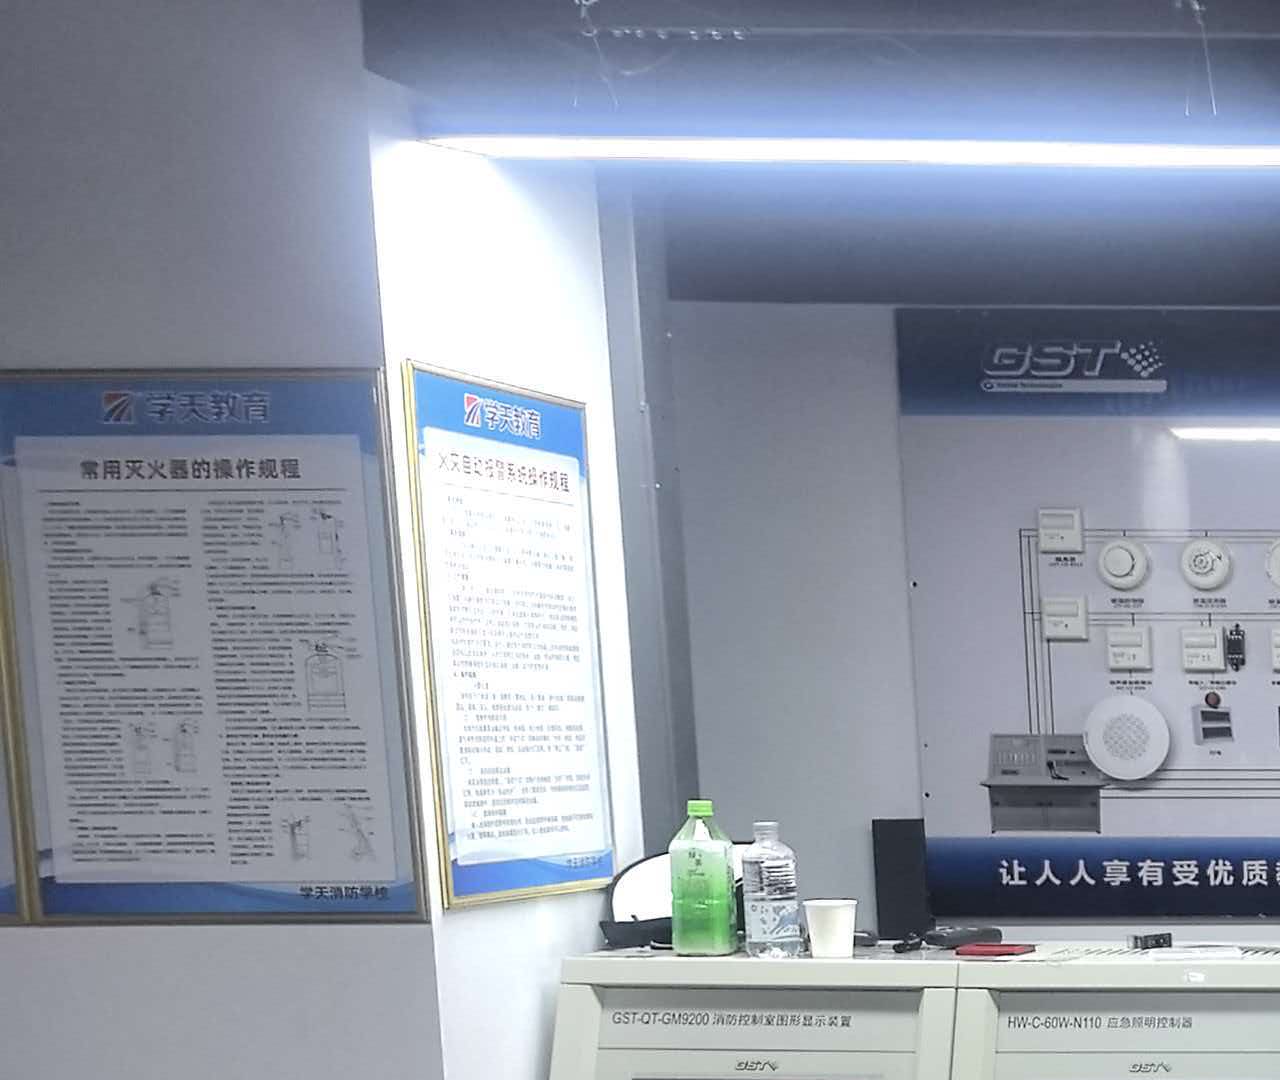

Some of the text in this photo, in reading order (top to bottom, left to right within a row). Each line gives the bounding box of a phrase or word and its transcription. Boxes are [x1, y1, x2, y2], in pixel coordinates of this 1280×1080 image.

[146, 390, 271, 424] 学天教育
[483, 399, 541, 440] 学天教育
[80, 458, 302, 480] 常用灭火器的操作规程
[612, 1012, 709, 1026] GST-QT-GM9200
[1008, 1015, 1101, 1029] HW-C-60W-N110
